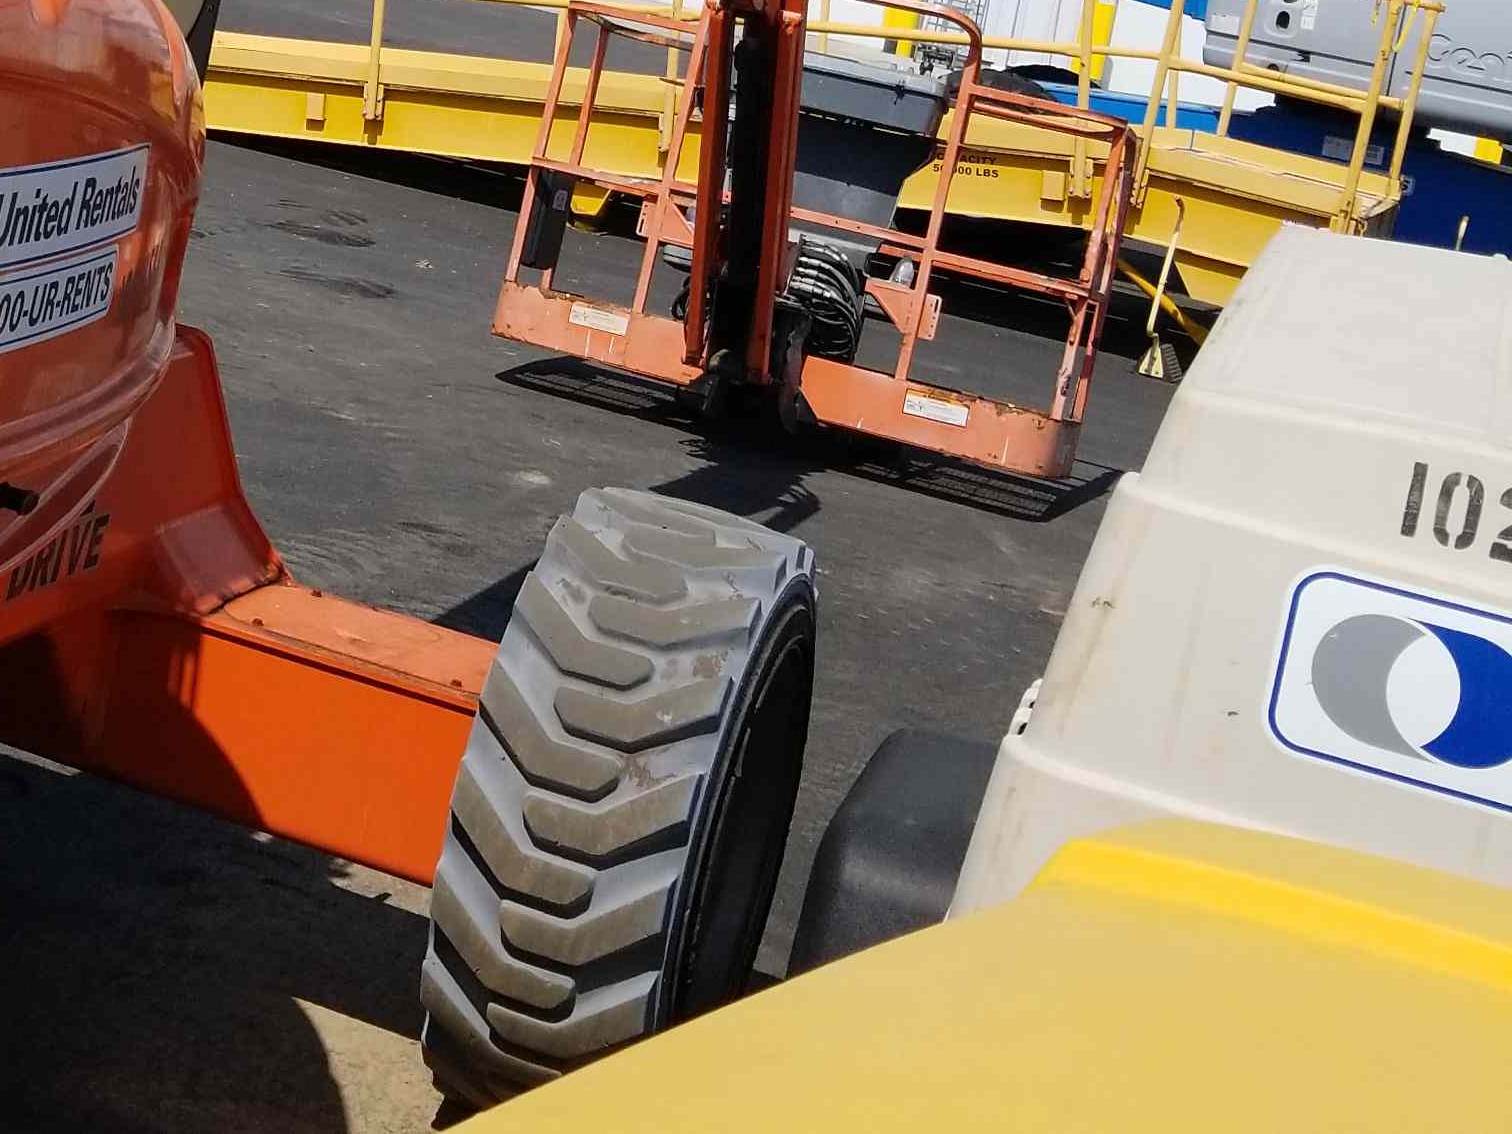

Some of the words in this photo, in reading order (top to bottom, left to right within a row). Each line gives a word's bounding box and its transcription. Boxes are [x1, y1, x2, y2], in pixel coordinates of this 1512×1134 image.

[936, 152, 997, 165] CACITY
[976, 167, 999, 178] LBS
[75, 166, 140, 231] Rentals
[5, 513, 110, 603] DRIVE
